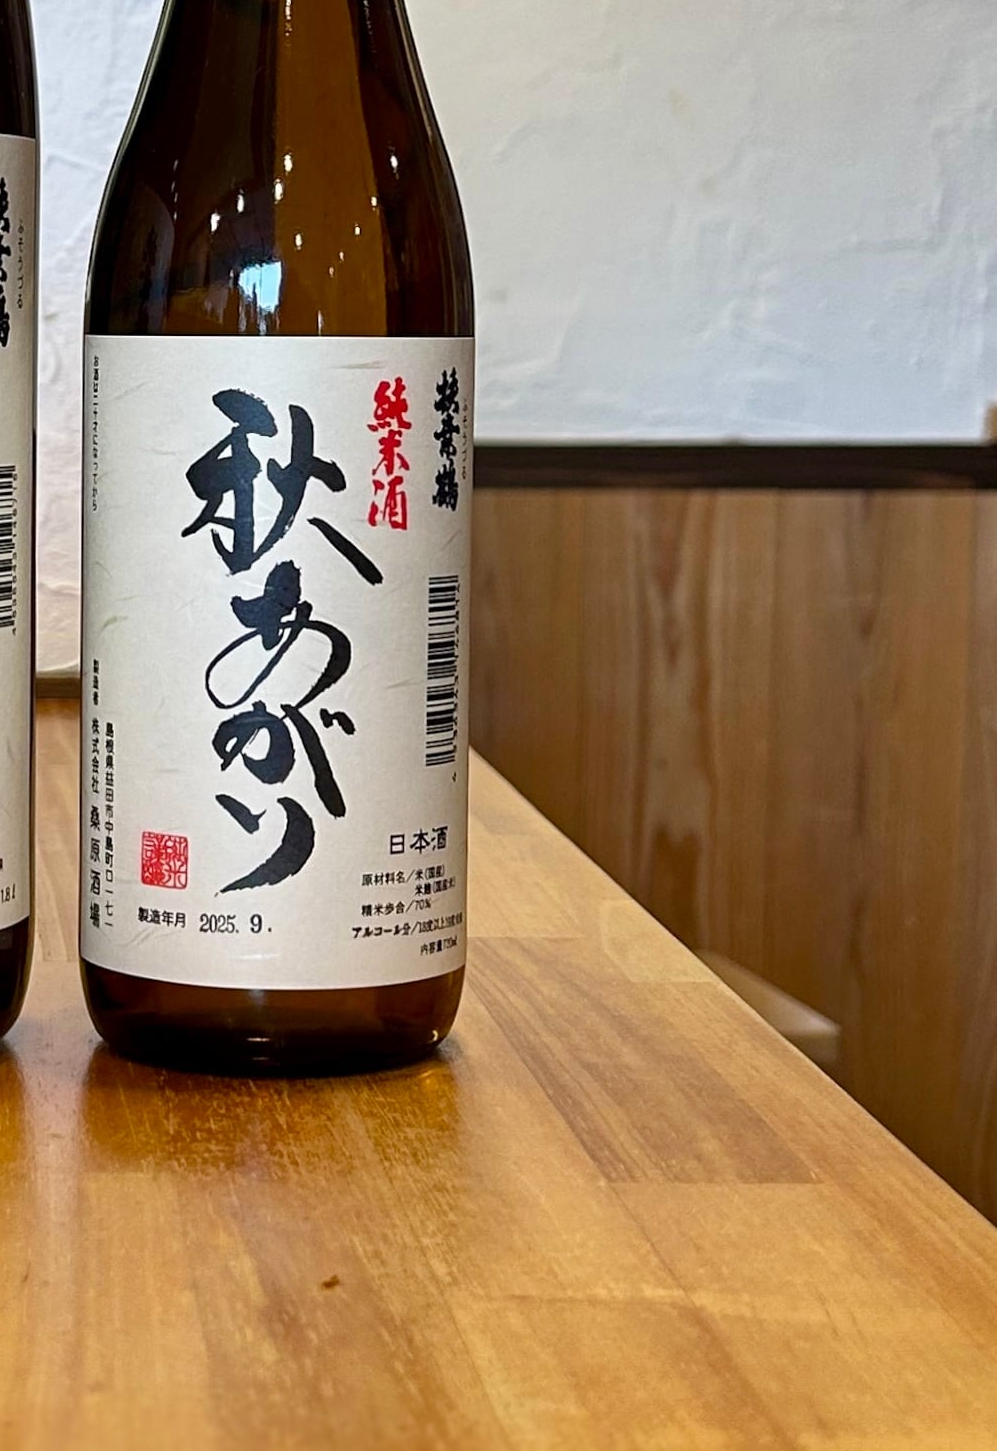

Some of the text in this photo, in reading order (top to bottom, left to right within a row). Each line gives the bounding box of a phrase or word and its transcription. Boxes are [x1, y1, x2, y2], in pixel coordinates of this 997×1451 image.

[367, 377, 412, 530] 純米酒
[181, 388, 384, 897] 秋あがり
[390, 825, 449, 855] 日本酒
[137, 906, 186, 929] 製造年月
[200, 912, 240, 934] 2025.
